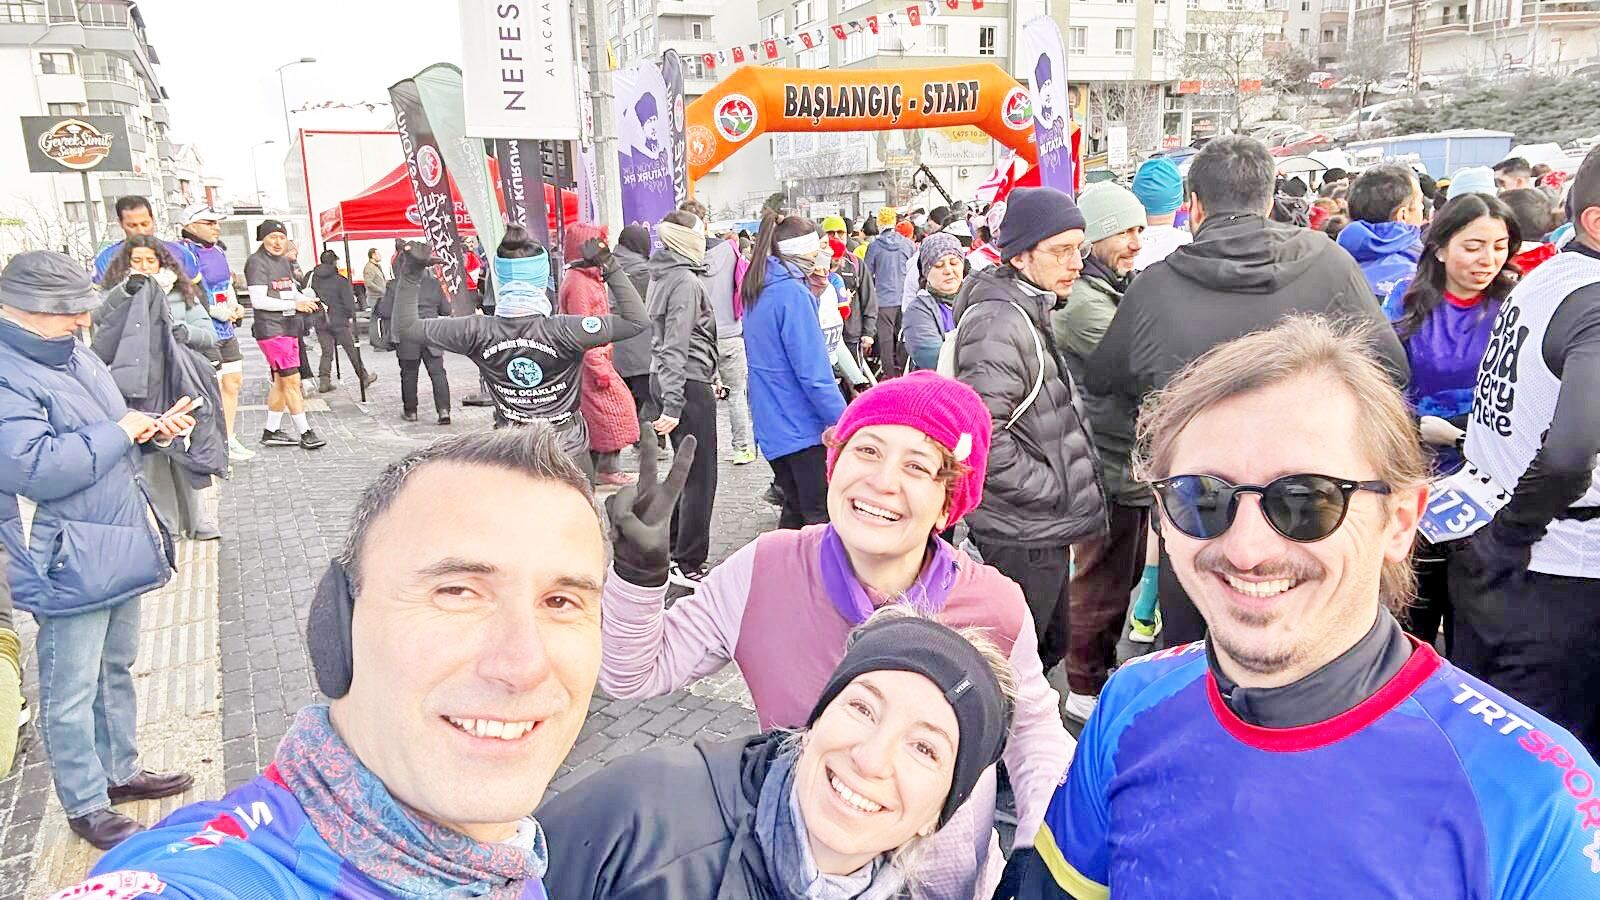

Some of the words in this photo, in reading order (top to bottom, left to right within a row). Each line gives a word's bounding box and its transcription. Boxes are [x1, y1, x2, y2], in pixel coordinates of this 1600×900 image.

[497, 4, 526, 110] NEFES
[784, 85, 902, 125] BAŞLANGIÇ
[922, 81, 979, 115] START
[1482, 325, 1530, 384] old
[1472, 396, 1513, 437] here
